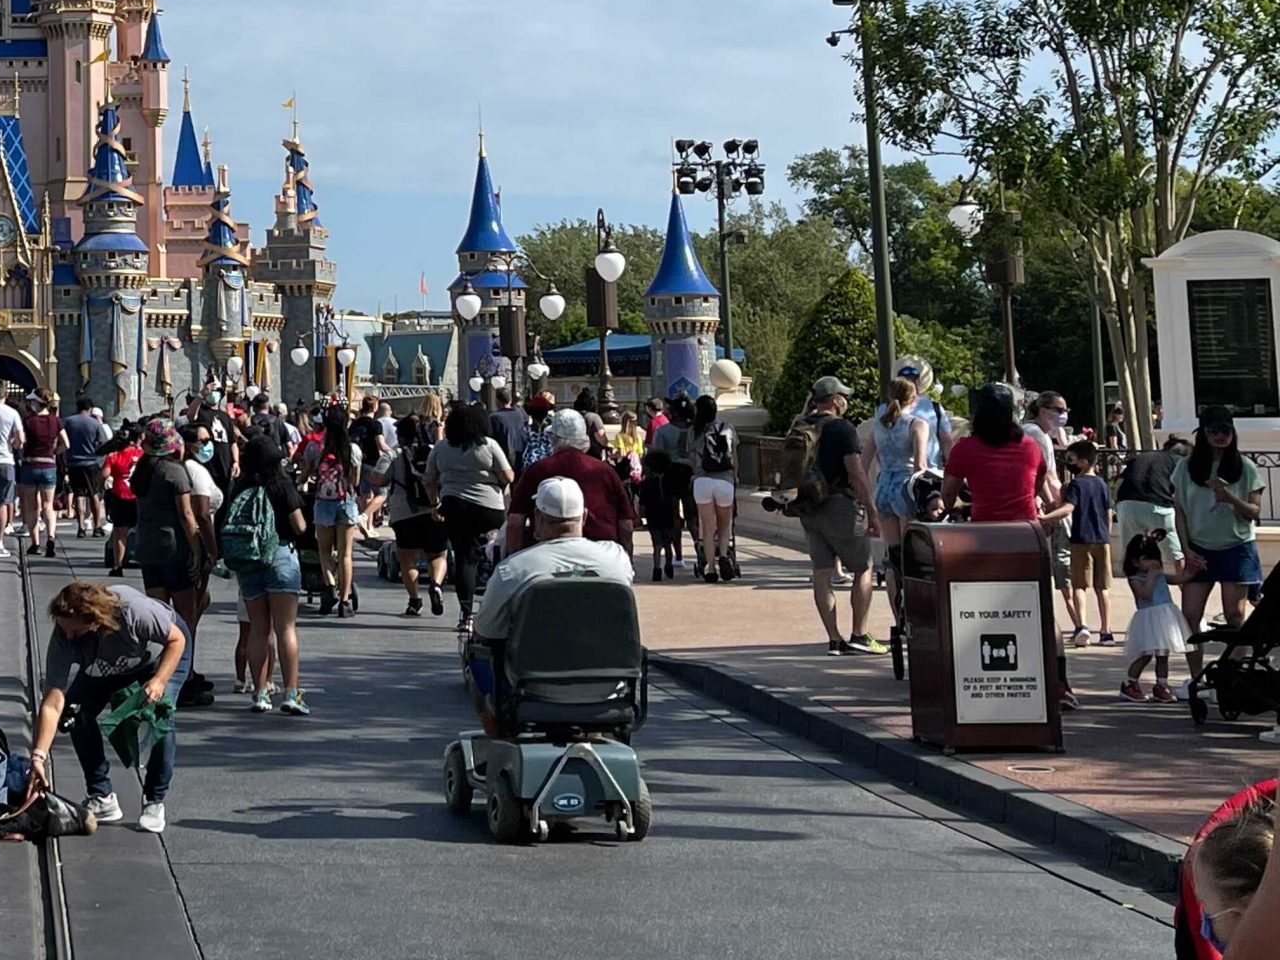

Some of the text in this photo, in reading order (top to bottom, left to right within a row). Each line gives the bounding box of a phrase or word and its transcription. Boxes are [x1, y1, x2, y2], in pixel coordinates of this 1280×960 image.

[959, 610, 1031, 619] FOR YOUR SAFETY
